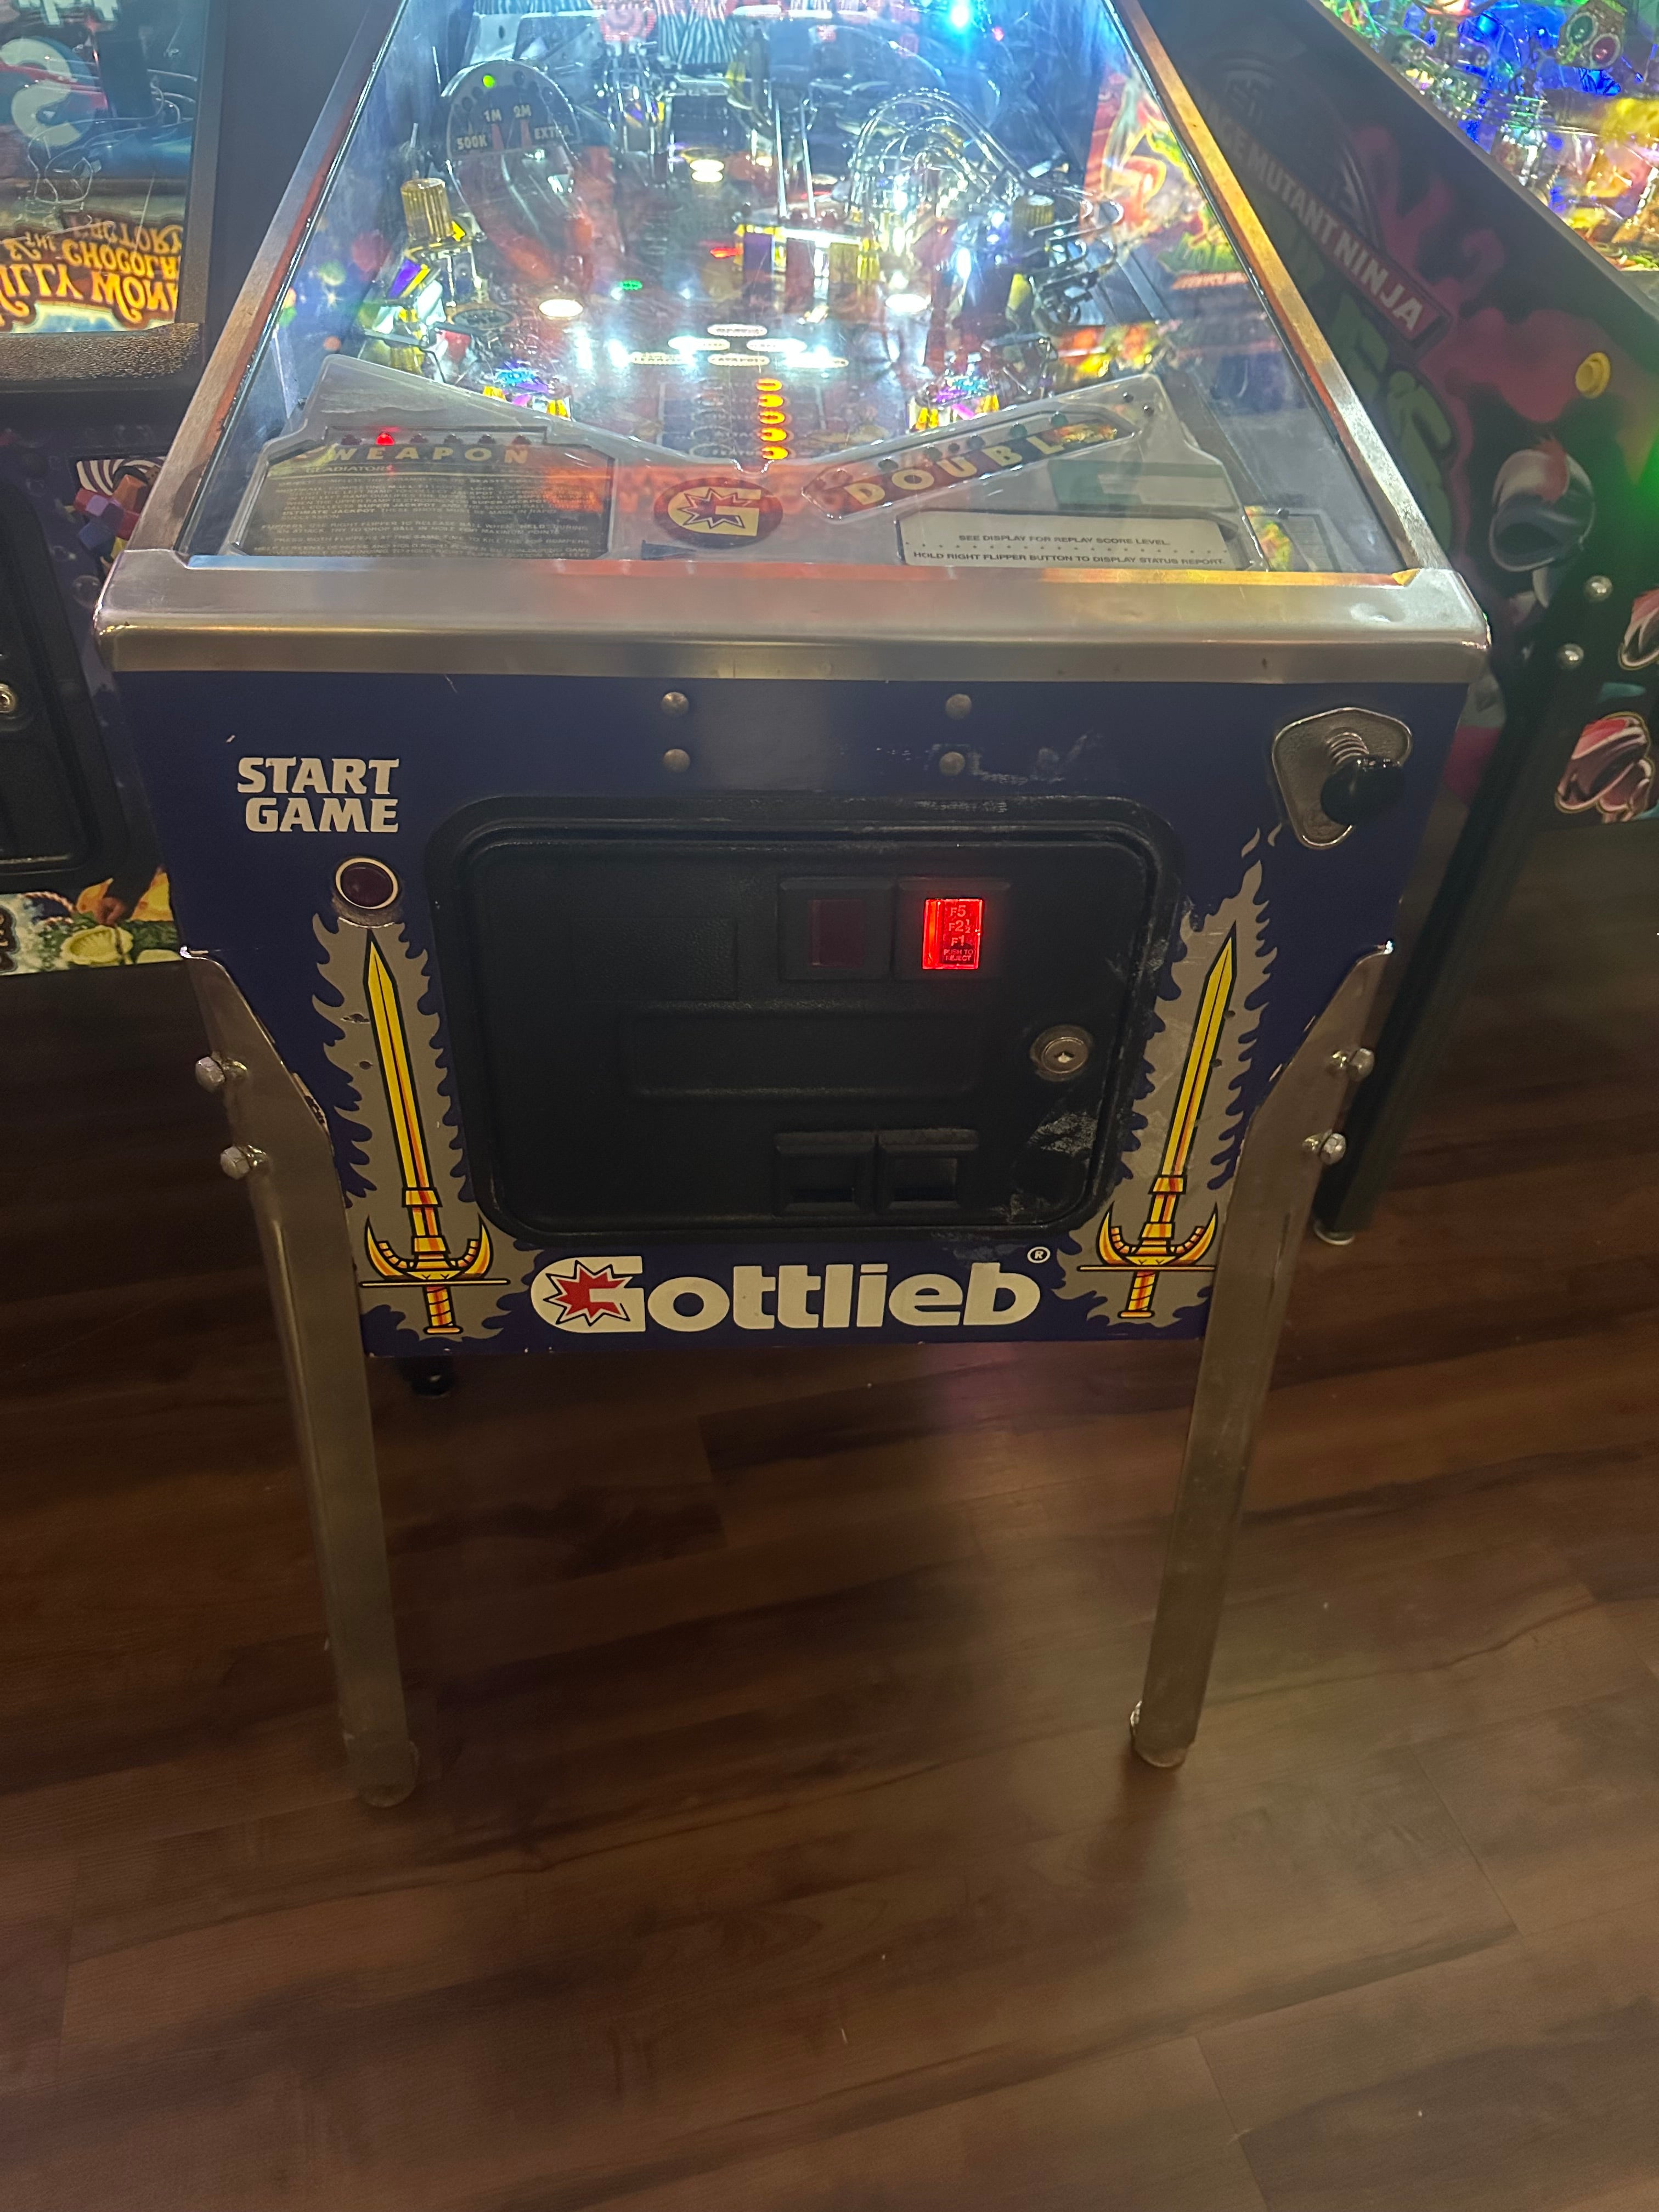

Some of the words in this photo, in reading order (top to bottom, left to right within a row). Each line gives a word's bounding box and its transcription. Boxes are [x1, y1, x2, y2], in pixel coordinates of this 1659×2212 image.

[483, 109, 502, 122] 1M
[513, 104, 532, 119] 2M
[456, 134, 487, 150] 500K
[1244, 144, 1339, 245] MUTANT
[1333, 230, 1423, 331] NINJA
[332, 447, 528, 464] WEAPON
[237, 757, 399, 795] START
[246, 797, 399, 833] GAME
[950, 905, 967, 917] F5
[531, 1255, 1041, 1333] Gottlieb
